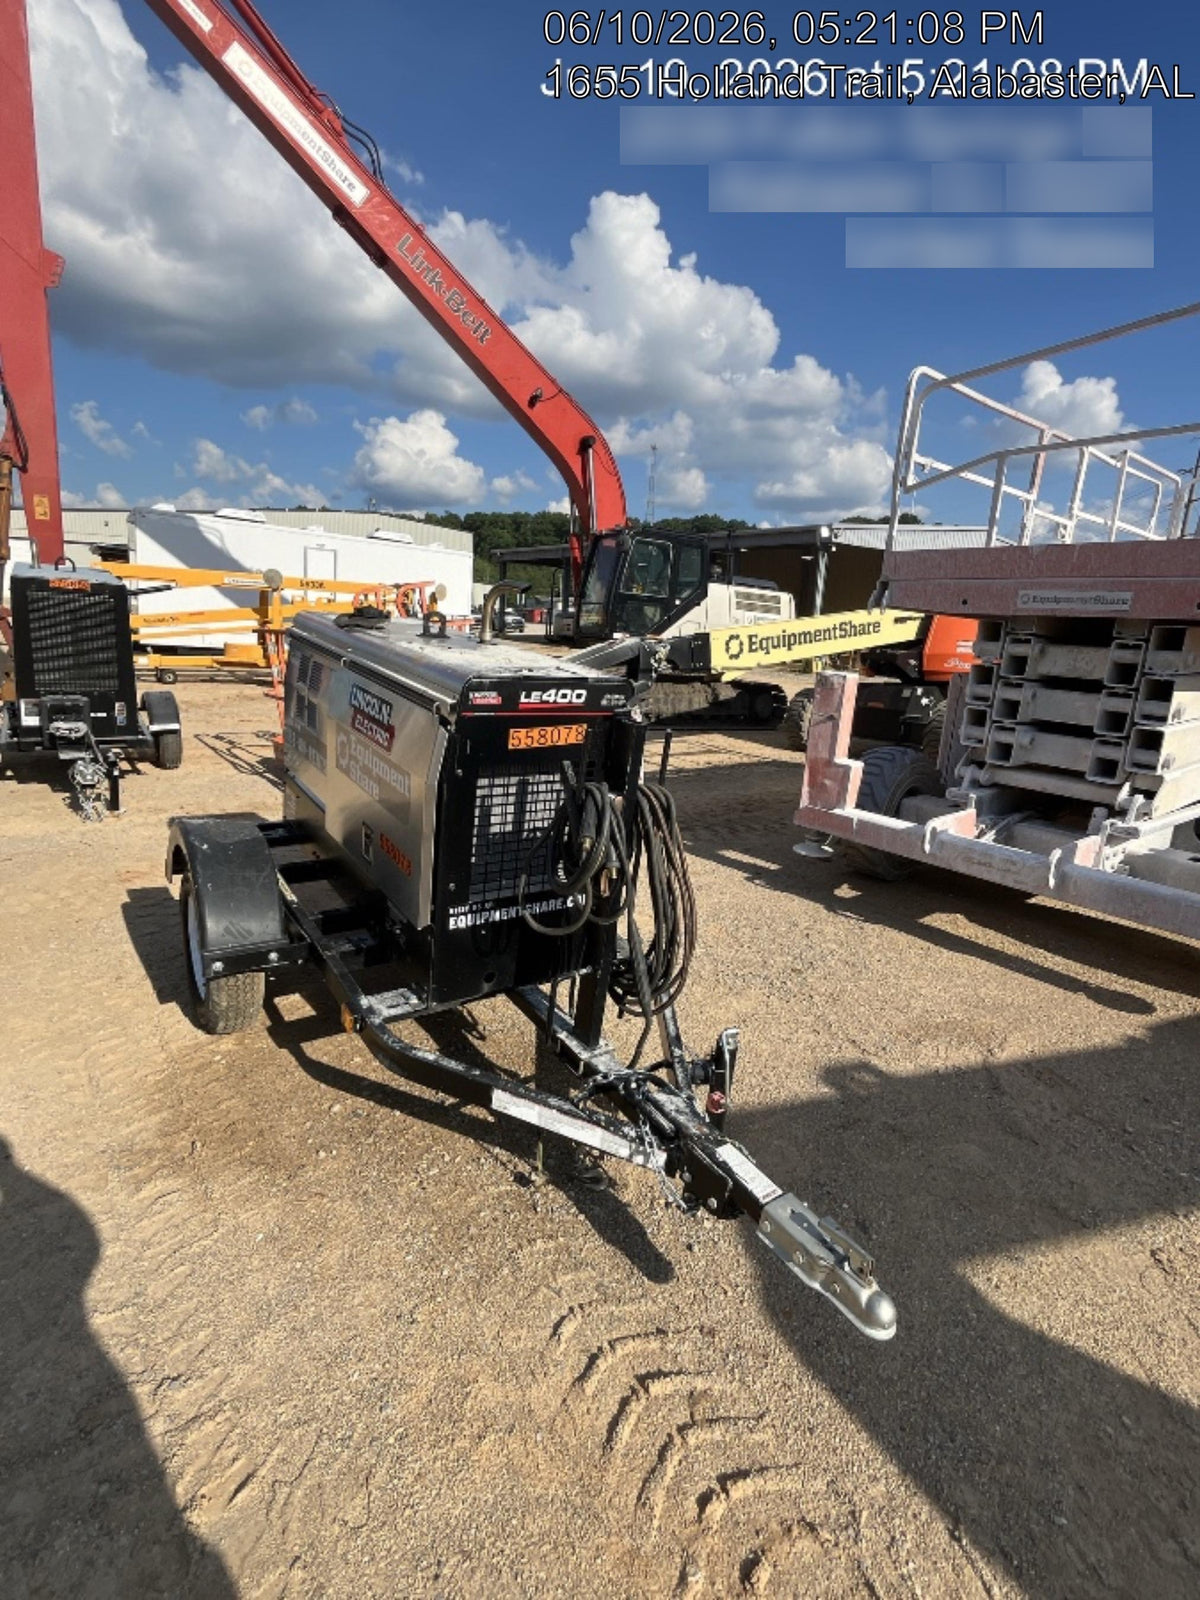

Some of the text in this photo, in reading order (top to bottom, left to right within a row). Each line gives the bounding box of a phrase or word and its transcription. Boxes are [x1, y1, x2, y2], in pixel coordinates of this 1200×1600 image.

[395, 232, 492, 346] Link-Belt
[747, 620, 881, 655] EquipmentShare
[520, 688, 587, 704] LE400
[511, 725, 586, 749] 558078
[350, 734, 410, 797] Equipment
